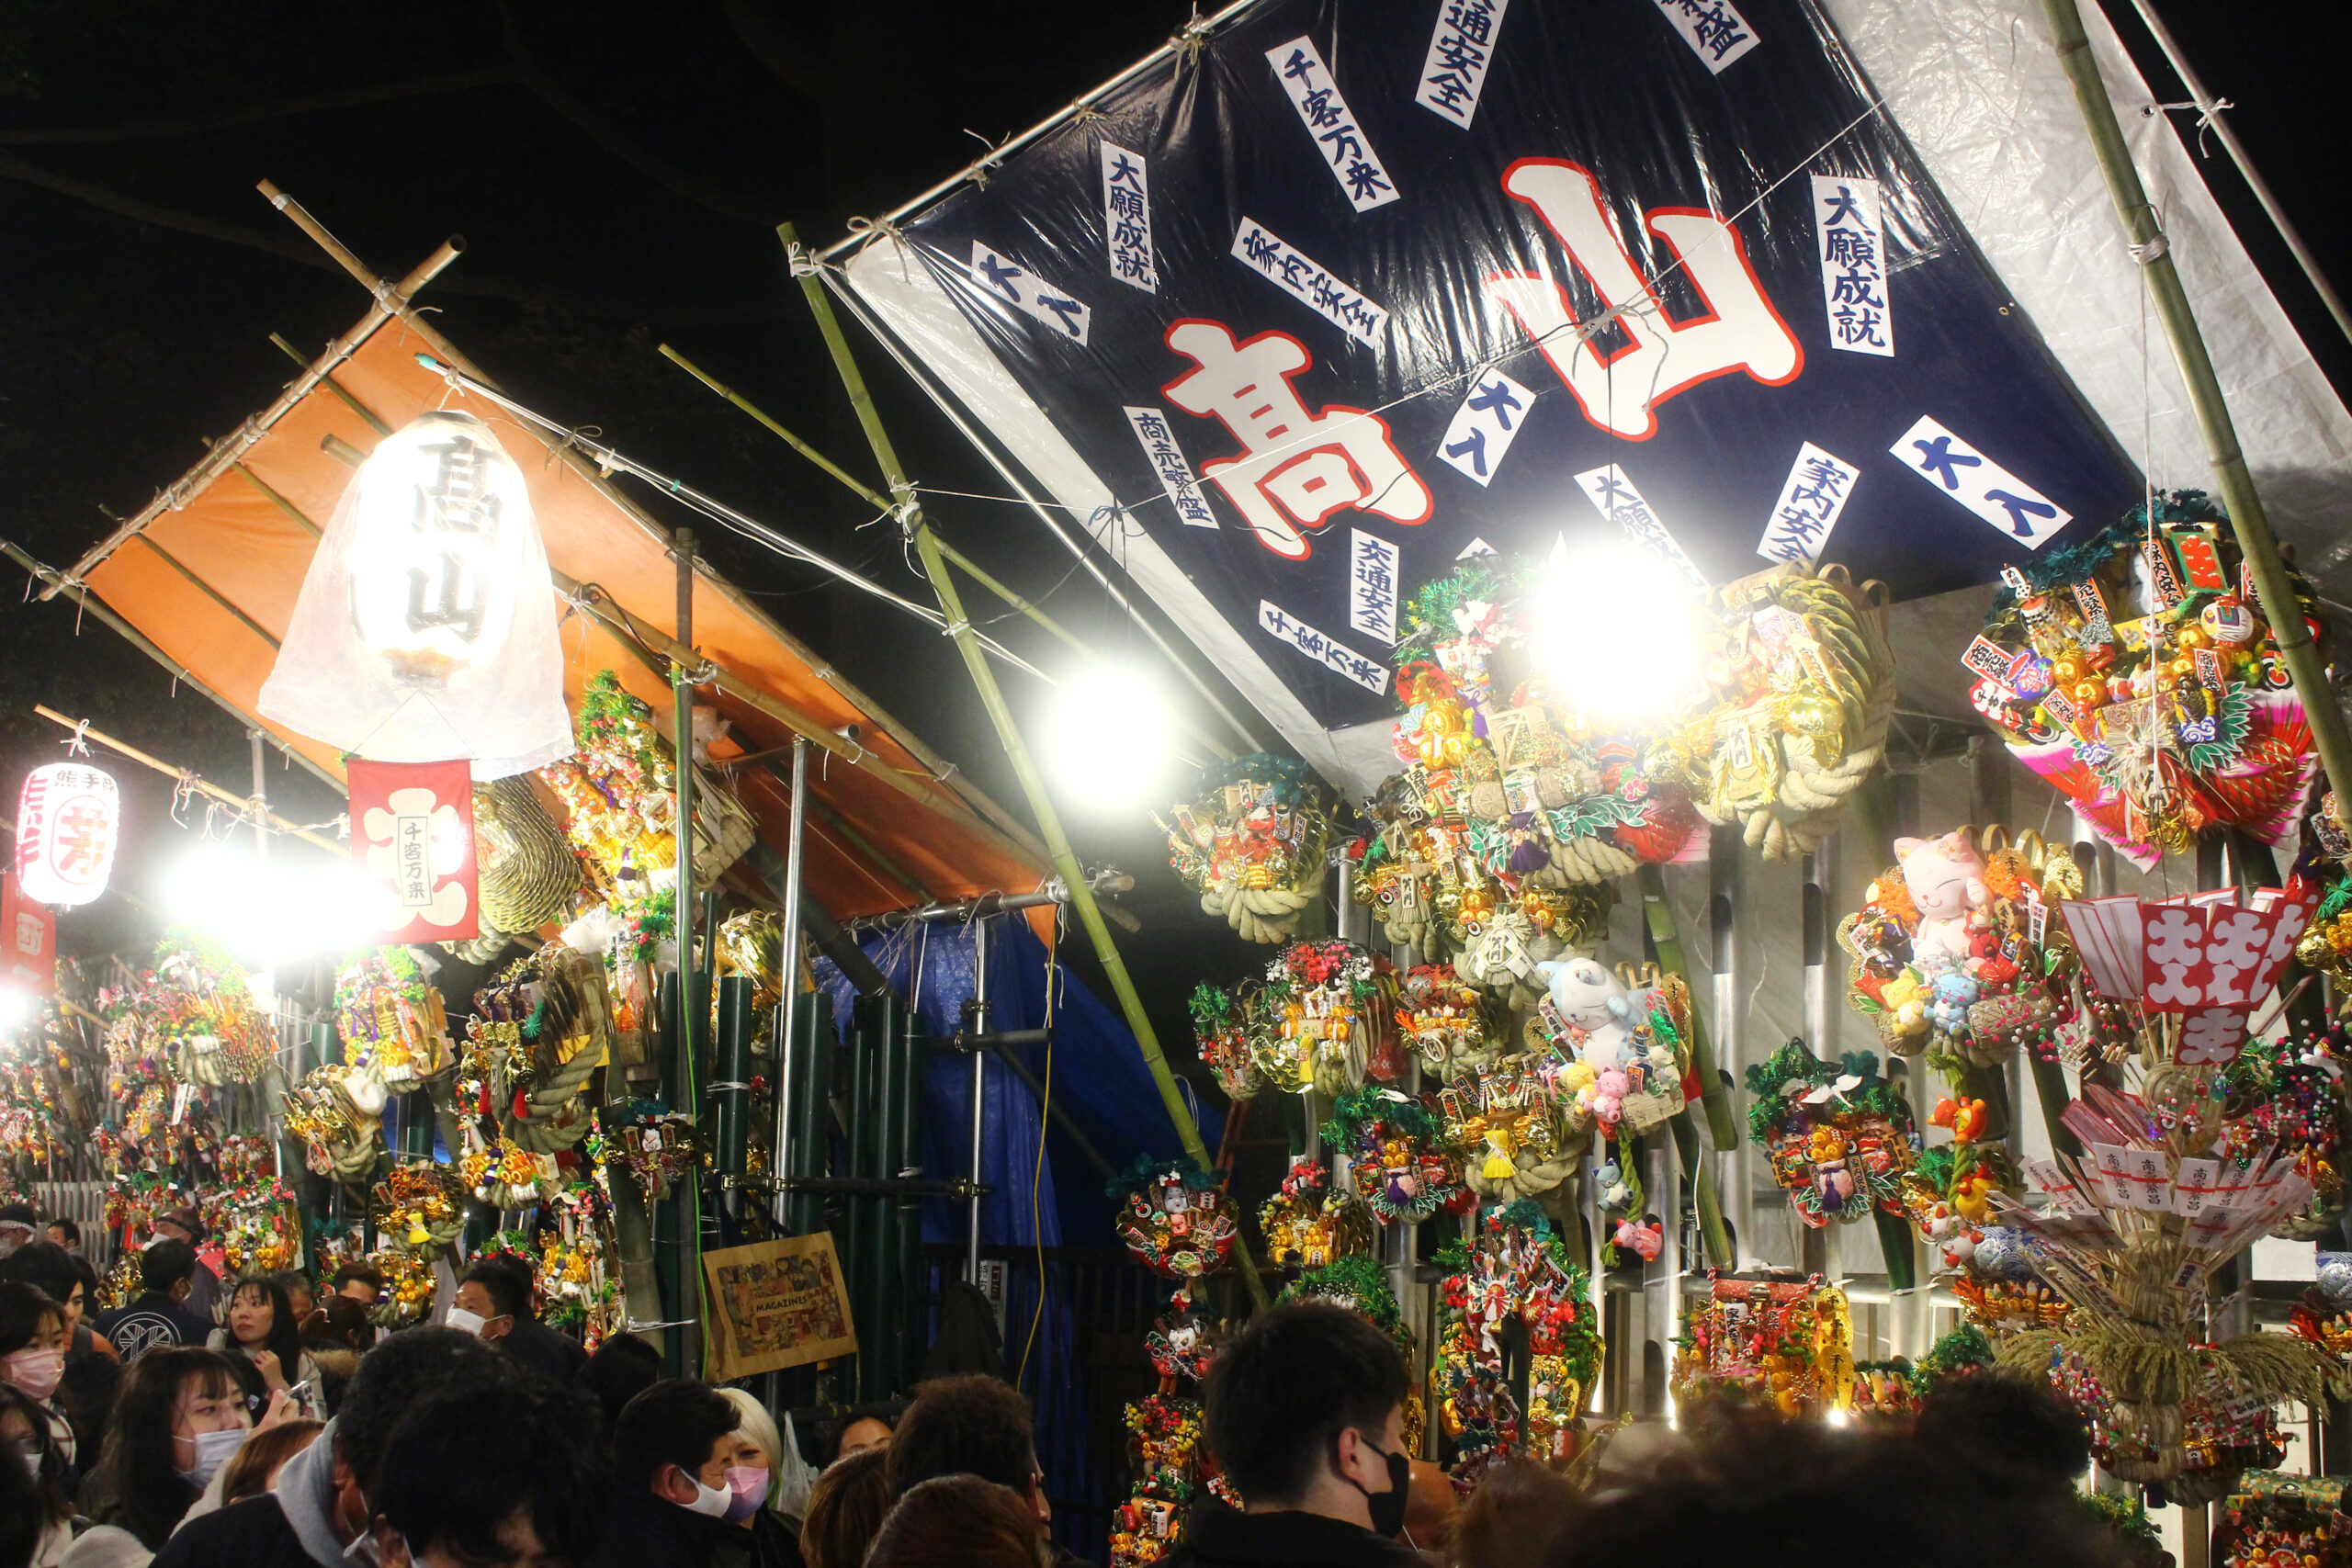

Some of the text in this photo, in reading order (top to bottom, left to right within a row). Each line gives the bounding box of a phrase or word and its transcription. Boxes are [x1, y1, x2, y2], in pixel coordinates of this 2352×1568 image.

[1426, 0, 1497, 118] 通安全
[1283, 49, 1392, 200] 千客万来
[1109, 154, 1152, 286] 大願成就
[1823, 186, 1886, 348] 大願成就
[978, 255, 1084, 337] 大入
[1241, 230, 1375, 336] 家内安全
[1134, 412, 1210, 524] 商売繁盛
[1445, 380, 1522, 478] 大入
[1768, 457, 1849, 563] 家内安全
[1913, 435, 2058, 536] 大入
[1355, 538, 1393, 637] 交通安全
[1265, 610, 1382, 691] 千客万来
[403, 821, 426, 900] 千客万来
[756, 1295, 807, 1312] MAGAZINES
